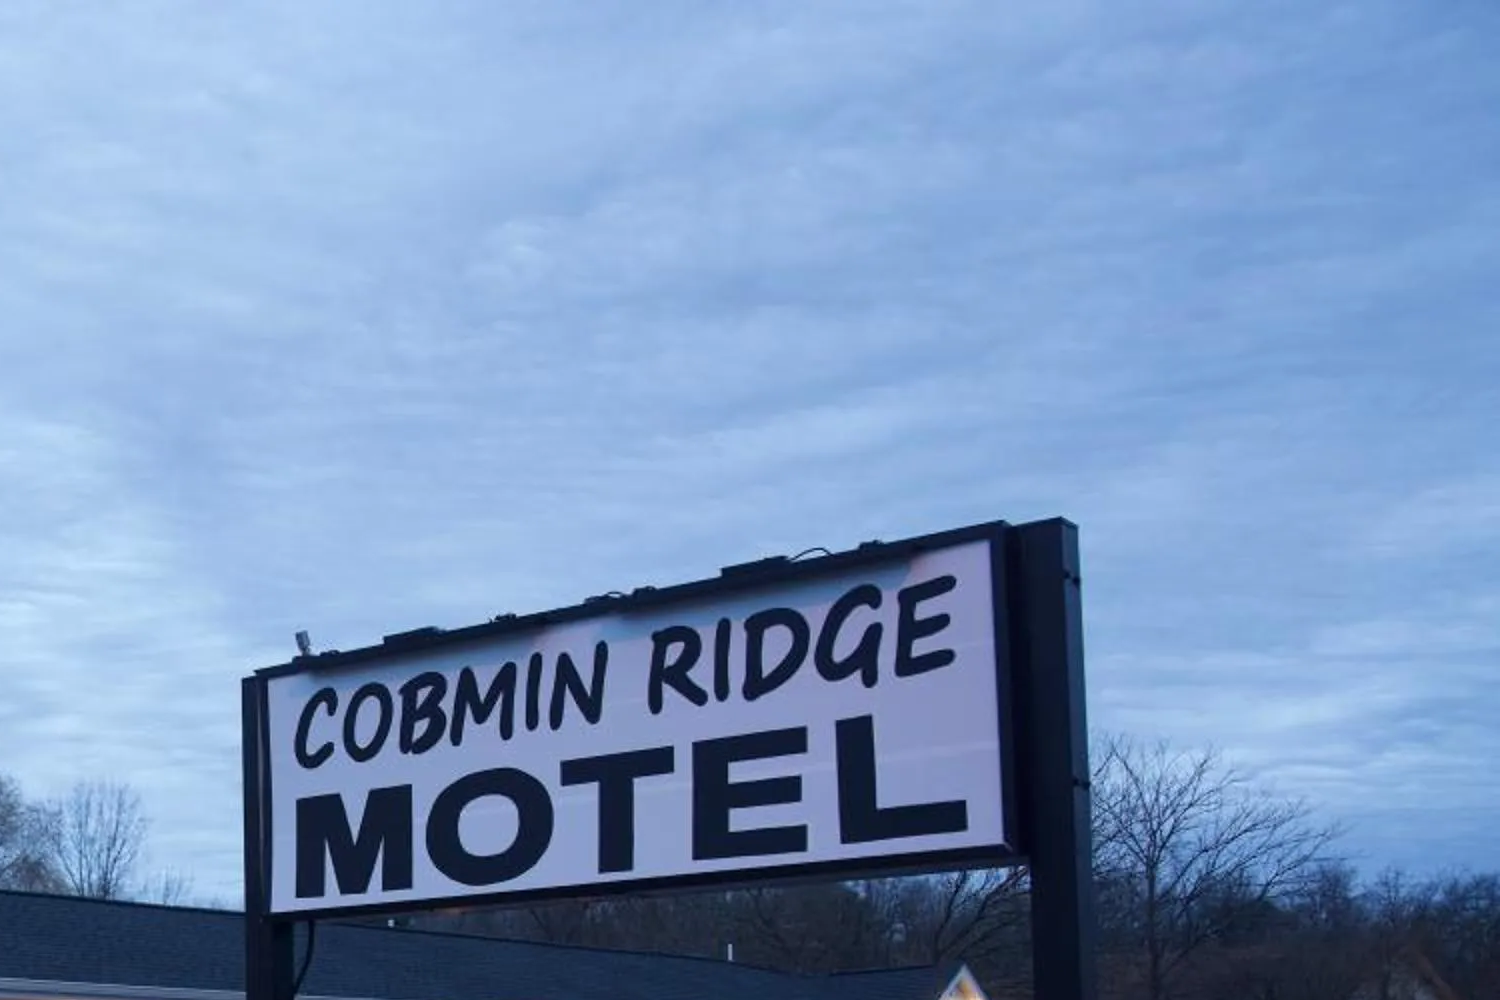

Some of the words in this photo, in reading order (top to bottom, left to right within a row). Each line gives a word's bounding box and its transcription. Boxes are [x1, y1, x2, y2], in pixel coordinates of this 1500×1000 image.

[294, 640, 609, 770] COBMIN
[647, 574, 958, 715] RIDGE
[294, 714, 969, 900] MOTEL
